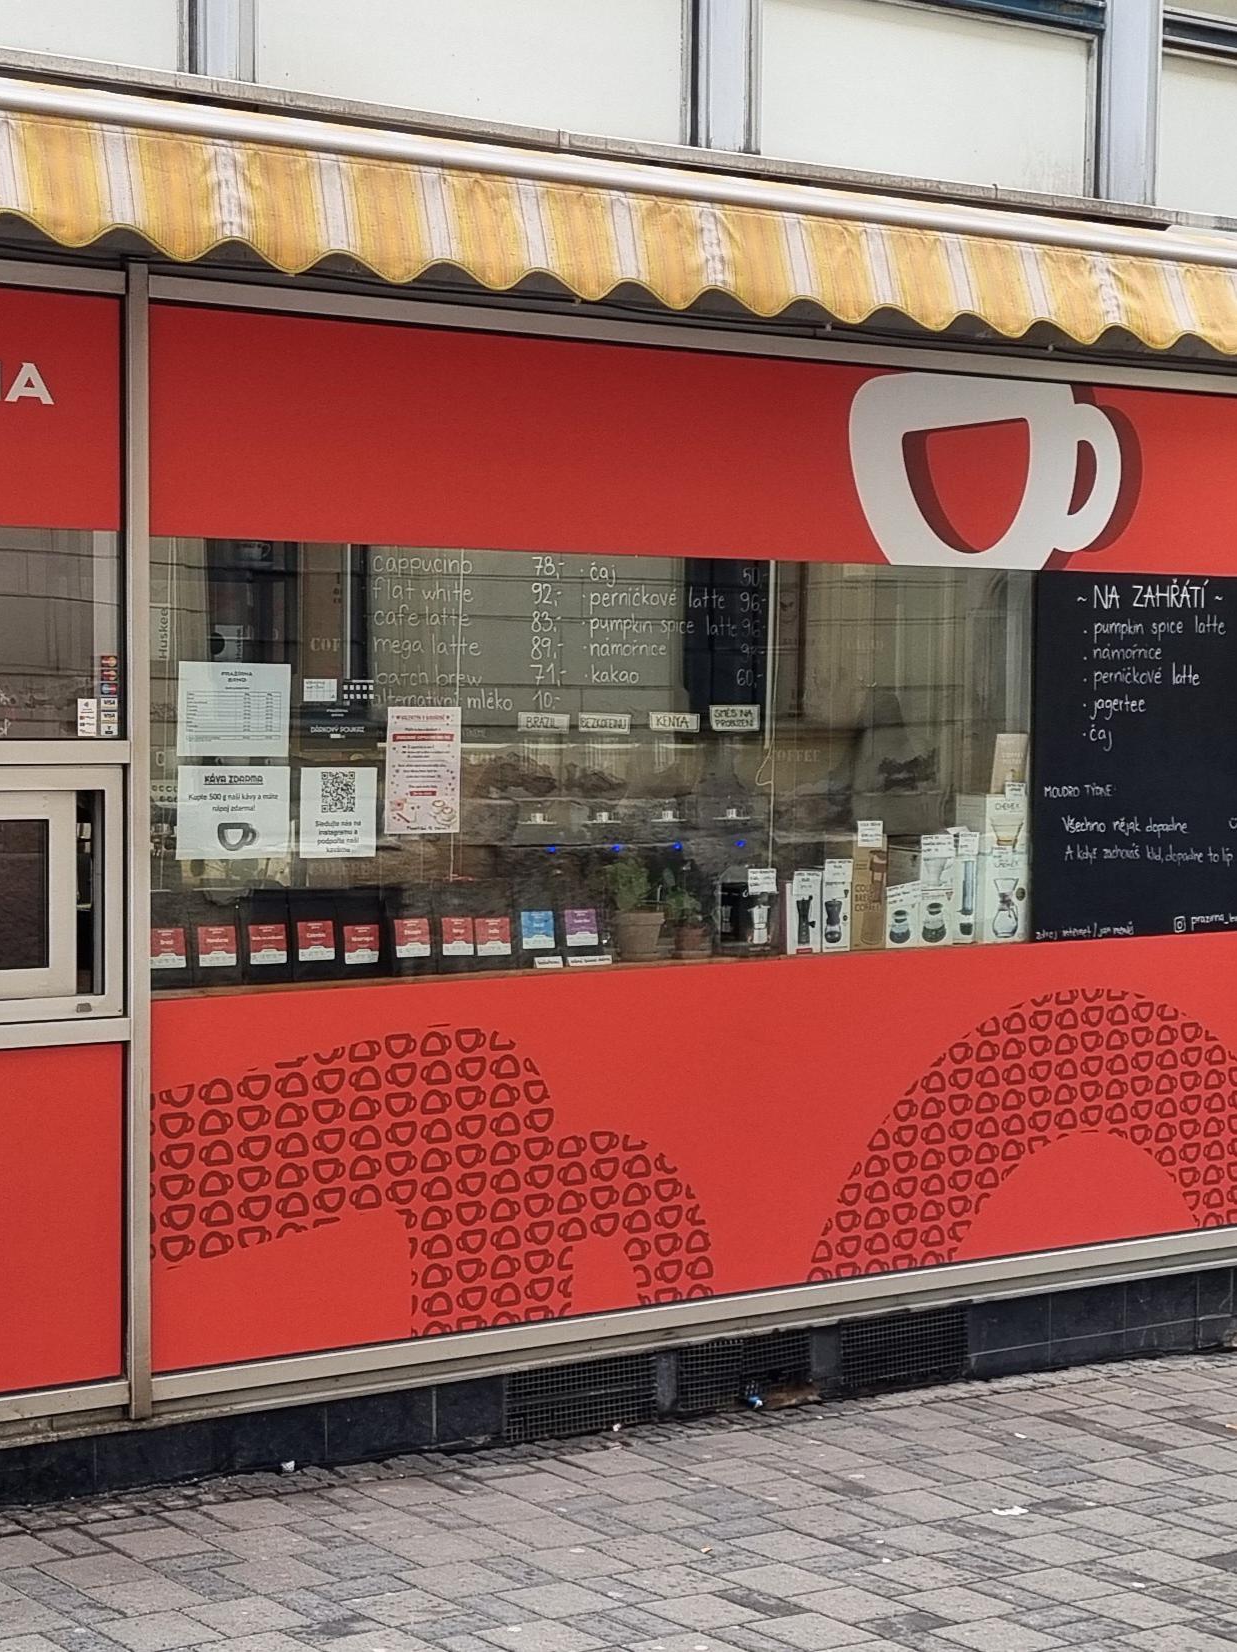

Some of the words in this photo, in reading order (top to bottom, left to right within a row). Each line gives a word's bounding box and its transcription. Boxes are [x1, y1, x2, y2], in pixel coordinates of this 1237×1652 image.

[373, 555, 473, 577] cappucino
[590, 562, 616, 587] čaj
[373, 576, 416, 600] flat
[422, 581, 474, 602] white
[590, 585, 677, 615] perničkové
[689, 586, 725, 609] latte
[1093, 584, 1120, 609] NA
[1132, 578, 1209, 608] ZAHŘÁTÍ
[425, 605, 471, 626] latte
[590, 613, 652, 640] pumpkin
[661, 619, 695, 640] spice
[706, 615, 738, 637] latte
[1094, 618, 1144, 643] pumpkin
[1151, 620, 1183, 641] spice
[1194, 614, 1226, 635] latte
[373, 636, 424, 659] mega
[432, 633, 481, 656] latte
[374, 662, 429, 685] batch
[435, 665, 482, 686] brew
[591, 664, 639, 684] kakao
[1093, 666, 1162, 691] perničkové
[1172, 662, 1201, 686] latte
[467, 688, 513, 711] mléko
[1089, 723, 1113, 751] čaj
[1044, 784, 1080, 798] MOUDRO
[1061, 815, 1106, 833] Všechno
[1113, 816, 1141, 836] nějak
[1145, 816, 1189, 838] dopadne
[1064, 845, 1074, 861] A
[1207, 846, 1219, 862] to
